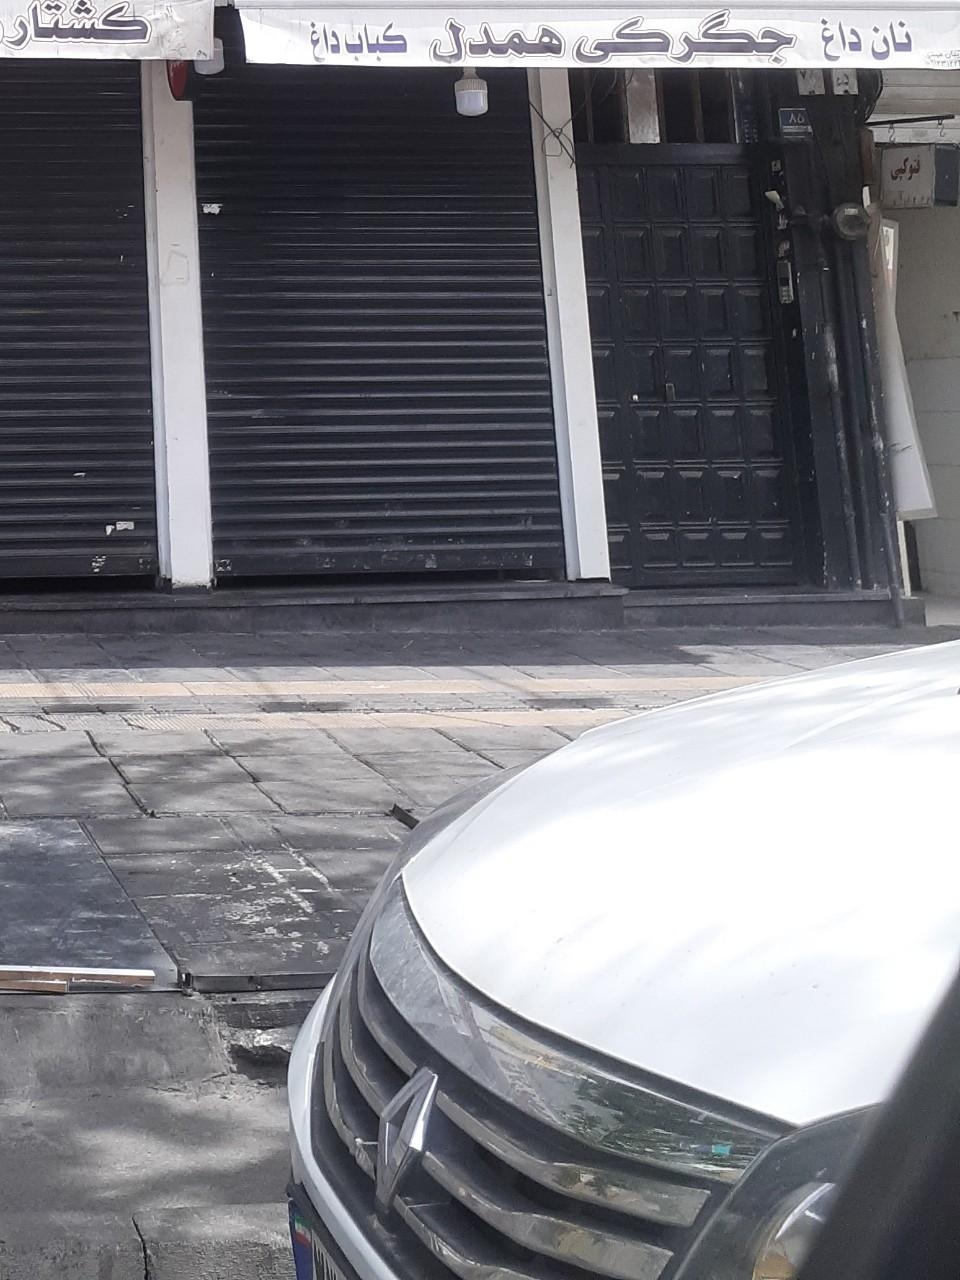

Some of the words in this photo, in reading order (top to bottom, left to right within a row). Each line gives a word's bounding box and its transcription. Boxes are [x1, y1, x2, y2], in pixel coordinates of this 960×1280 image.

[310, 22, 341, 62] داغ
[345, 21, 408, 61] کباب
[429, 19, 566, 64] همدل
[572, 9, 796, 65] جگرکی
[821, 18, 862, 61] داغ
[871, 20, 912, 61] نان
